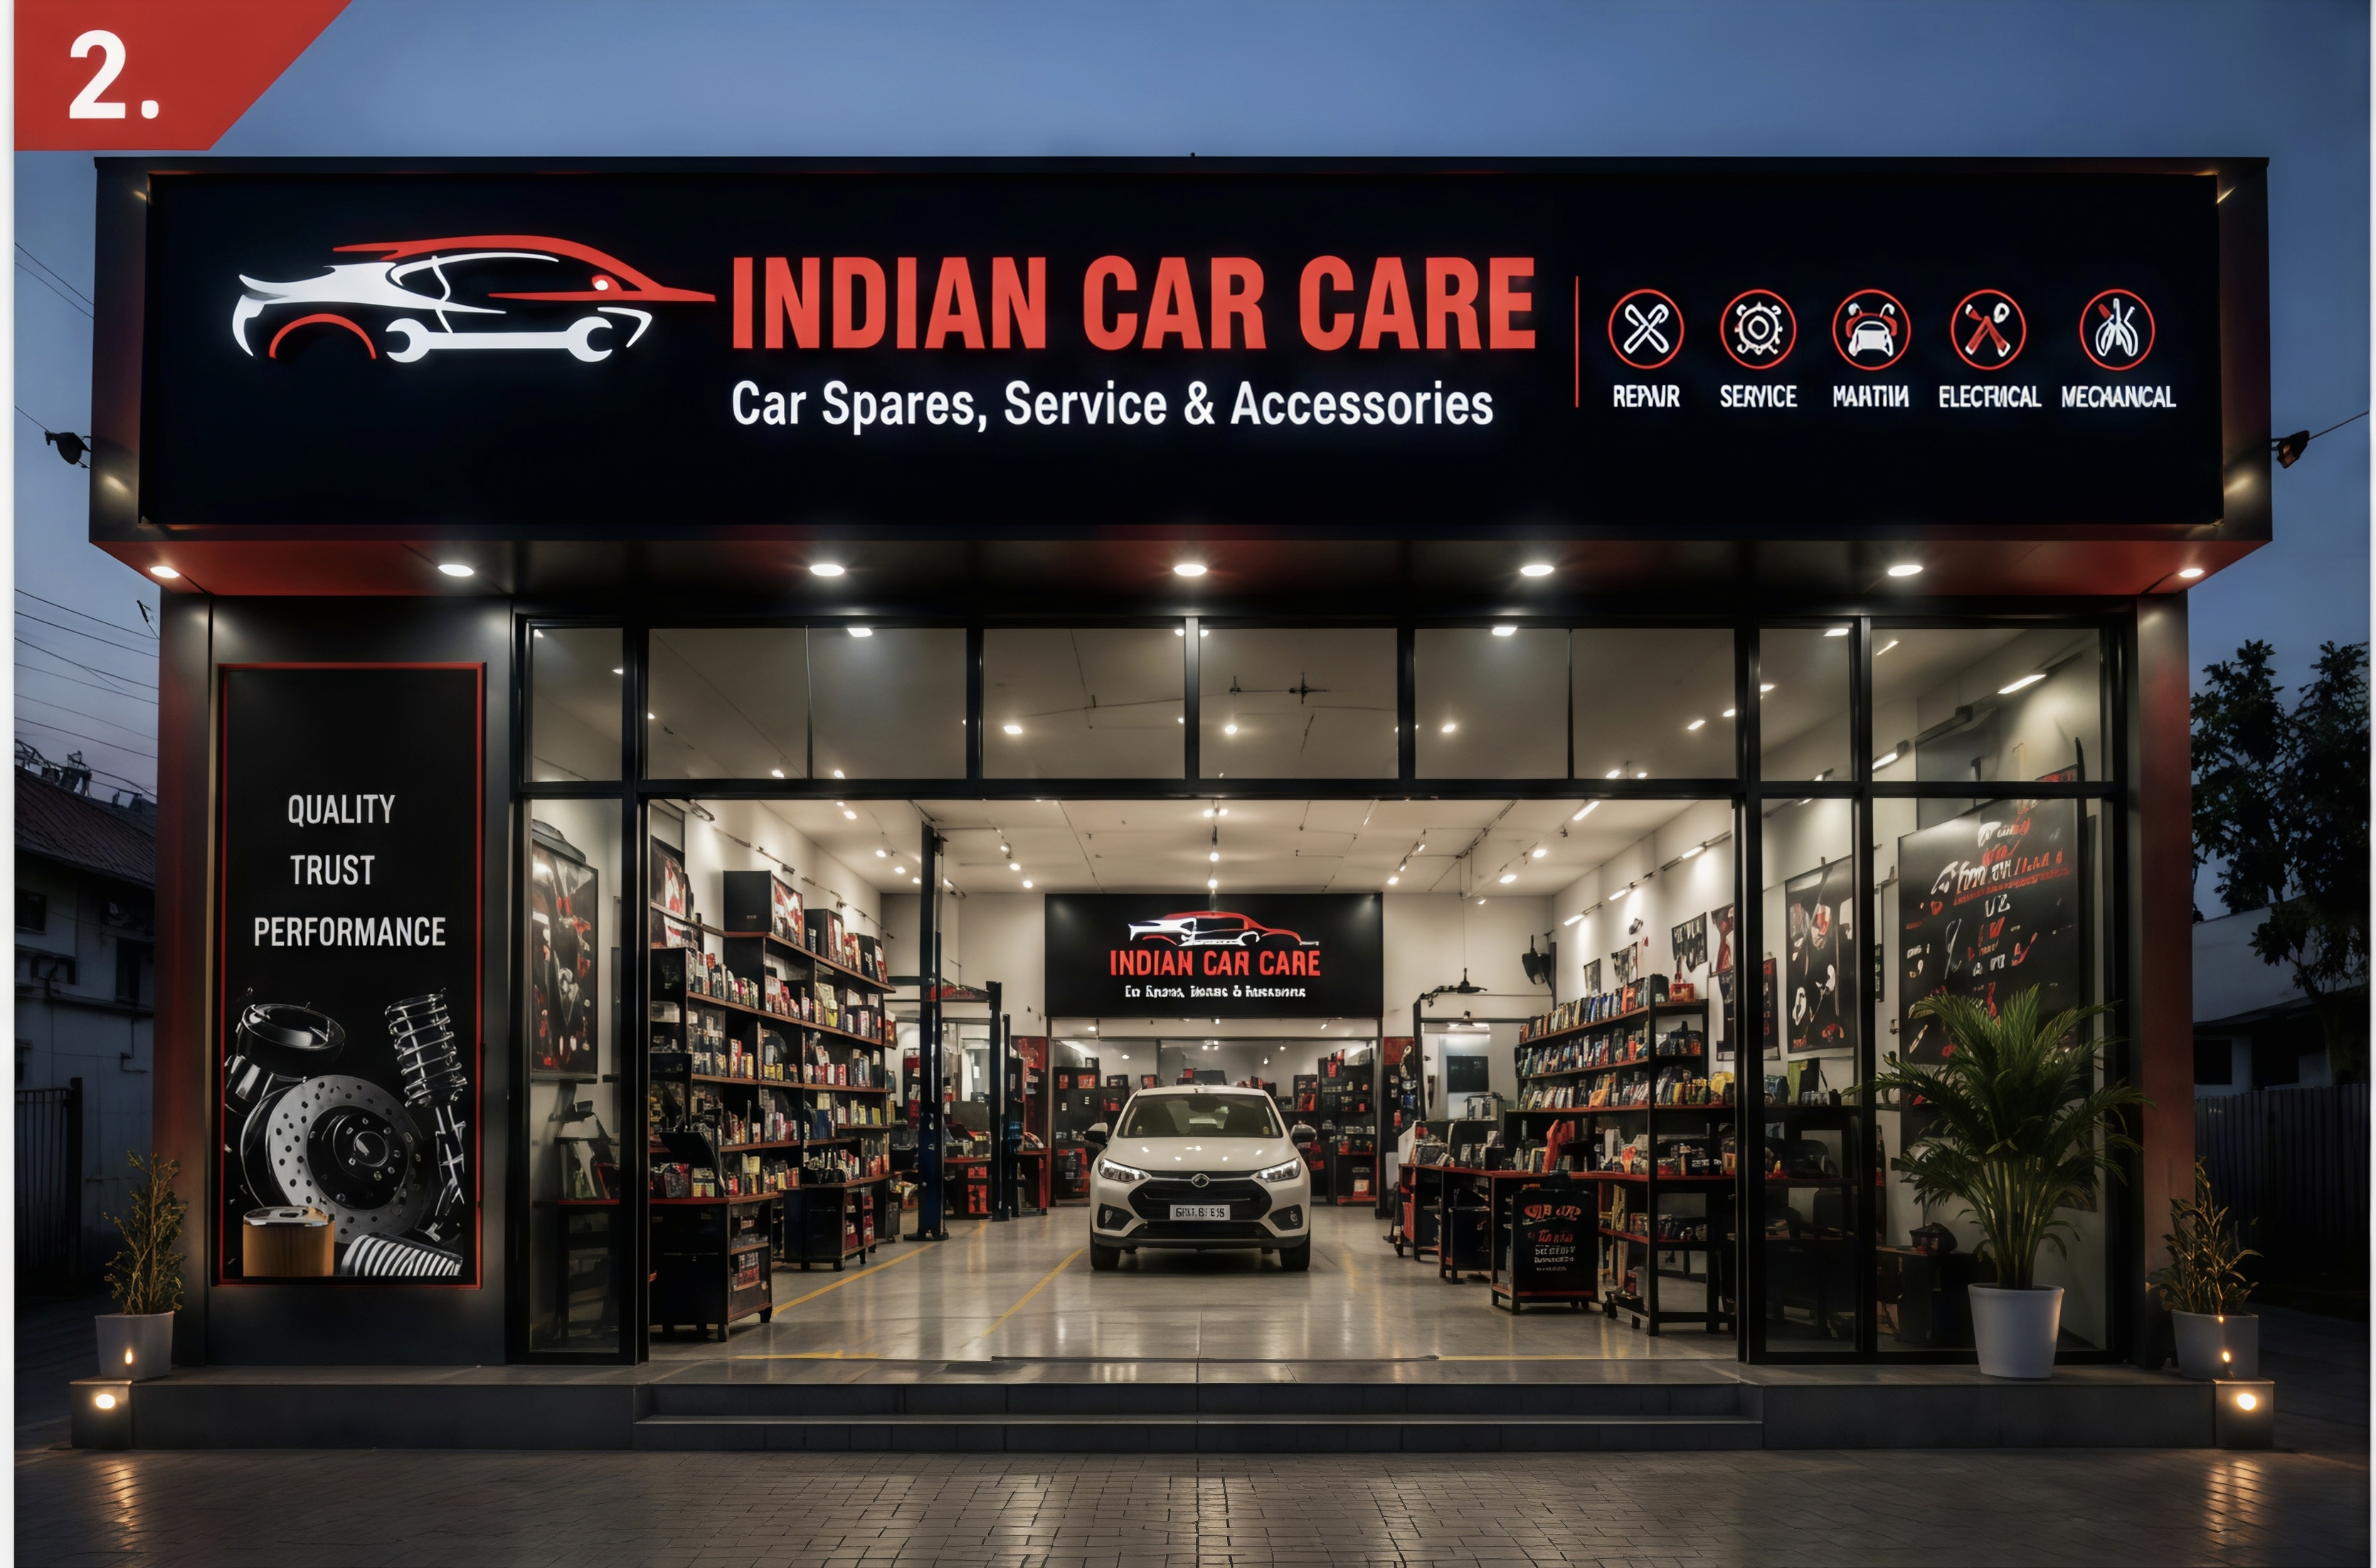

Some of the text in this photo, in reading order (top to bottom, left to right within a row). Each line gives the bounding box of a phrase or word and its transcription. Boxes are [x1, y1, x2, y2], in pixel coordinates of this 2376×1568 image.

[733, 255, 1536, 351] INDIAN CAR CARE
[732, 379, 1494, 435] Car Spares, Service & Accessories
[1720, 384, 1798, 408] SERVICE
[287, 794, 396, 827] QUALITY
[290, 854, 376, 885] TRUST
[254, 916, 446, 947] PERFORMANCE
[1110, 950, 1194, 976] INDIAN
[1259, 950, 1321, 977] CARE
